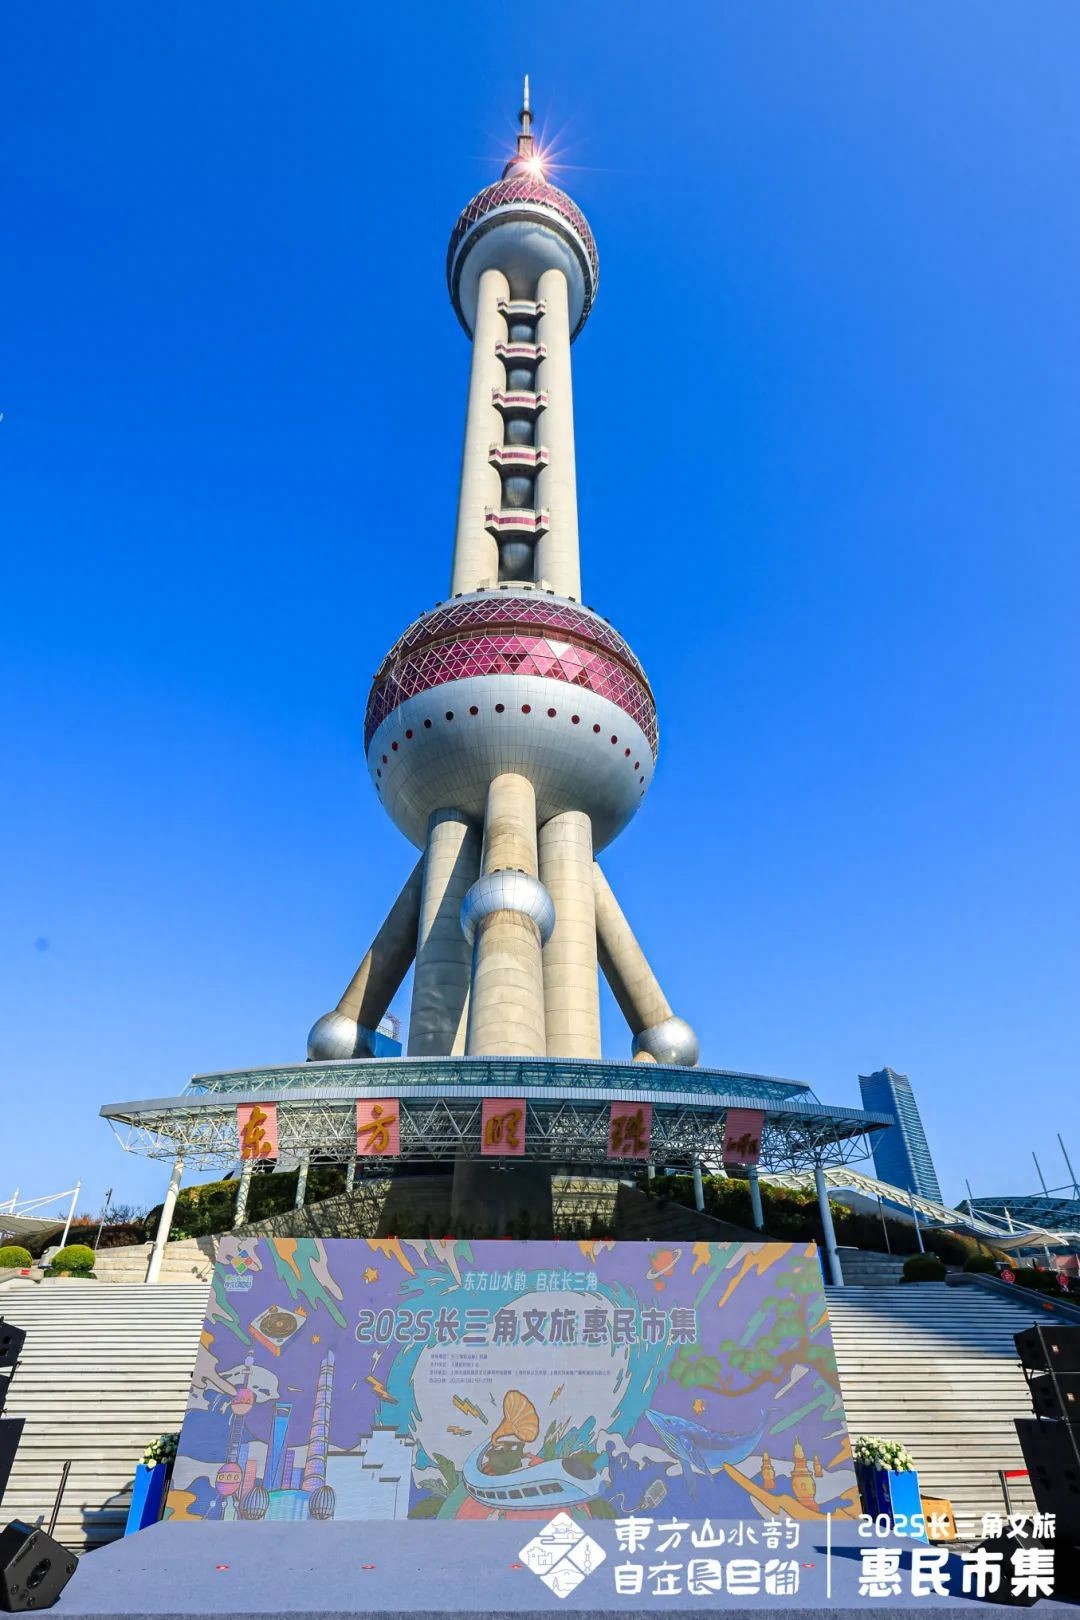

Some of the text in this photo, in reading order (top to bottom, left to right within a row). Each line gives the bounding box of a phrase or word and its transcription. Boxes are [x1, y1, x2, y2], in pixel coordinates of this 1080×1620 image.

[464, 1270, 598, 1292] 东方山水韵 自在长三角
[354, 1306, 697, 1346] 2025长三角文旅惠民市集
